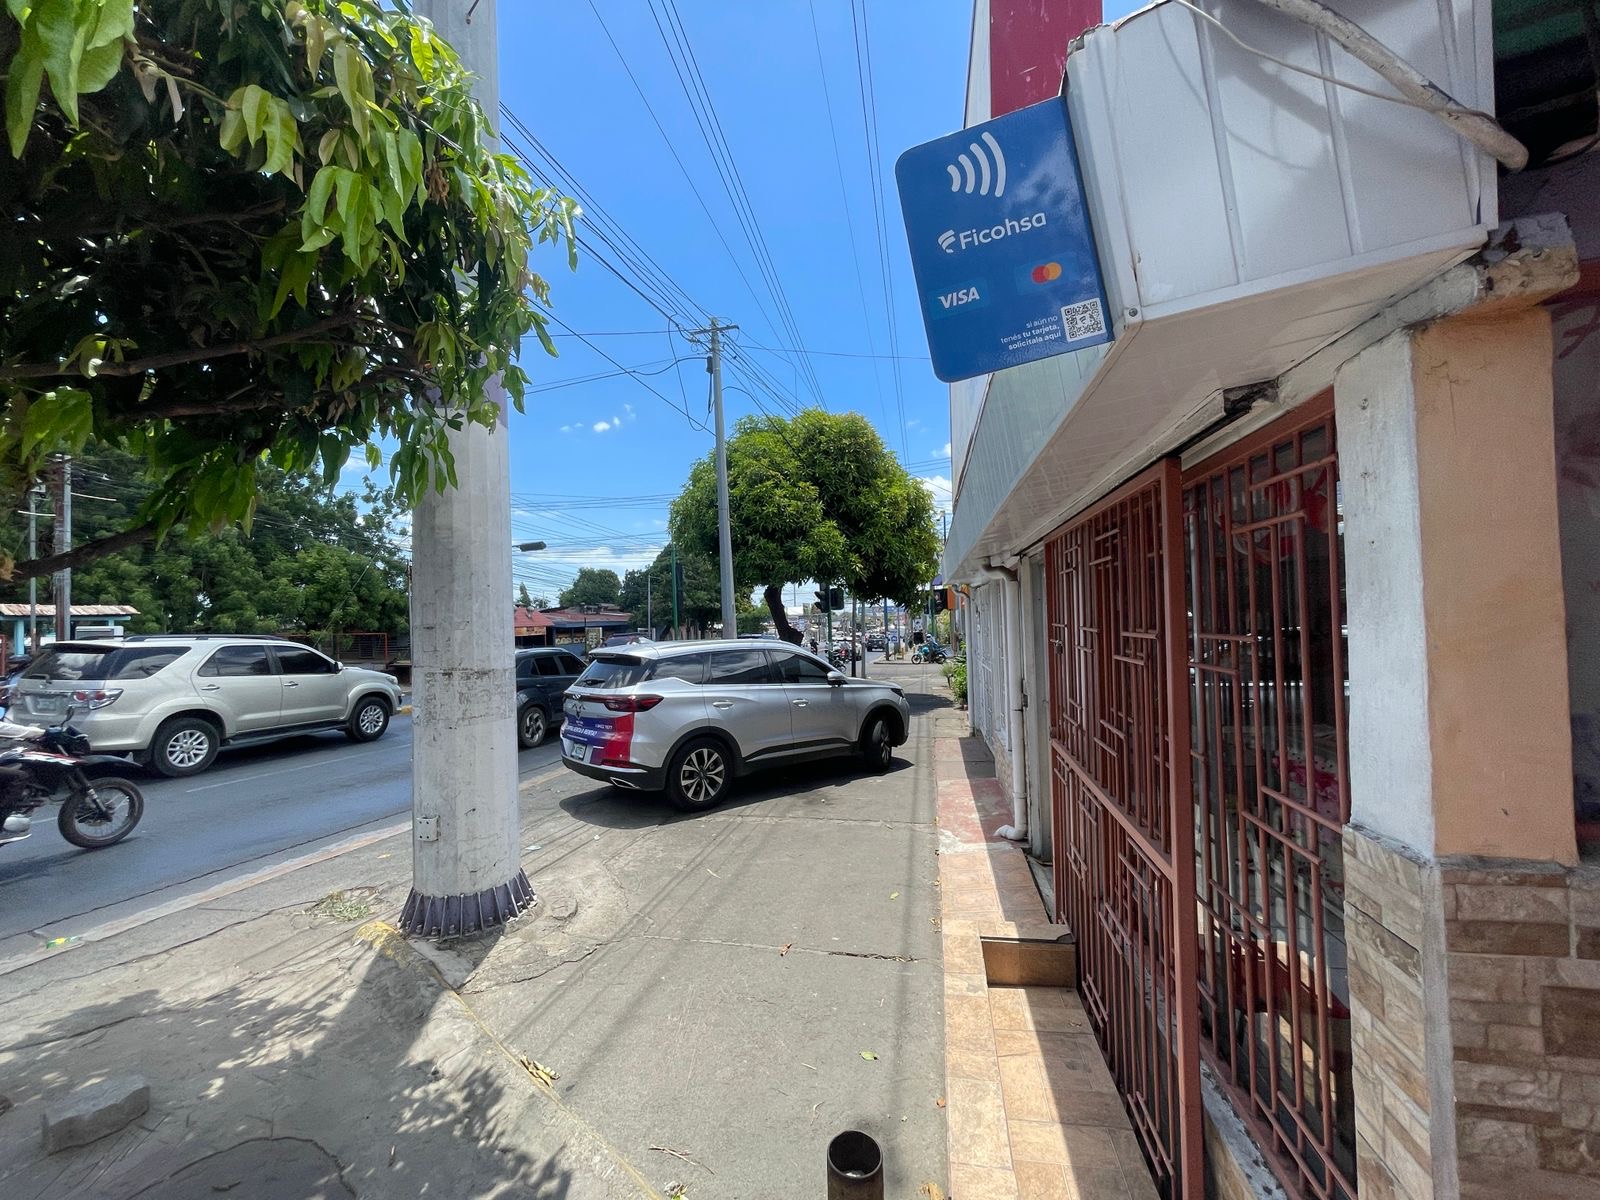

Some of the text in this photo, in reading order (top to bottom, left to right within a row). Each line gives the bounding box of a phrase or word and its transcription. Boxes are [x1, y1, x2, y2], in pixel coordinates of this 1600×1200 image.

[959, 213, 1047, 250] Ficohsa
[938, 286, 980, 308] VISA
[1026, 315, 1058, 329] si aún no
[1000, 332, 1022, 344] tenés
[1032, 324, 1060, 335] tarjeta,
[1044, 329, 1061, 340] aquí
